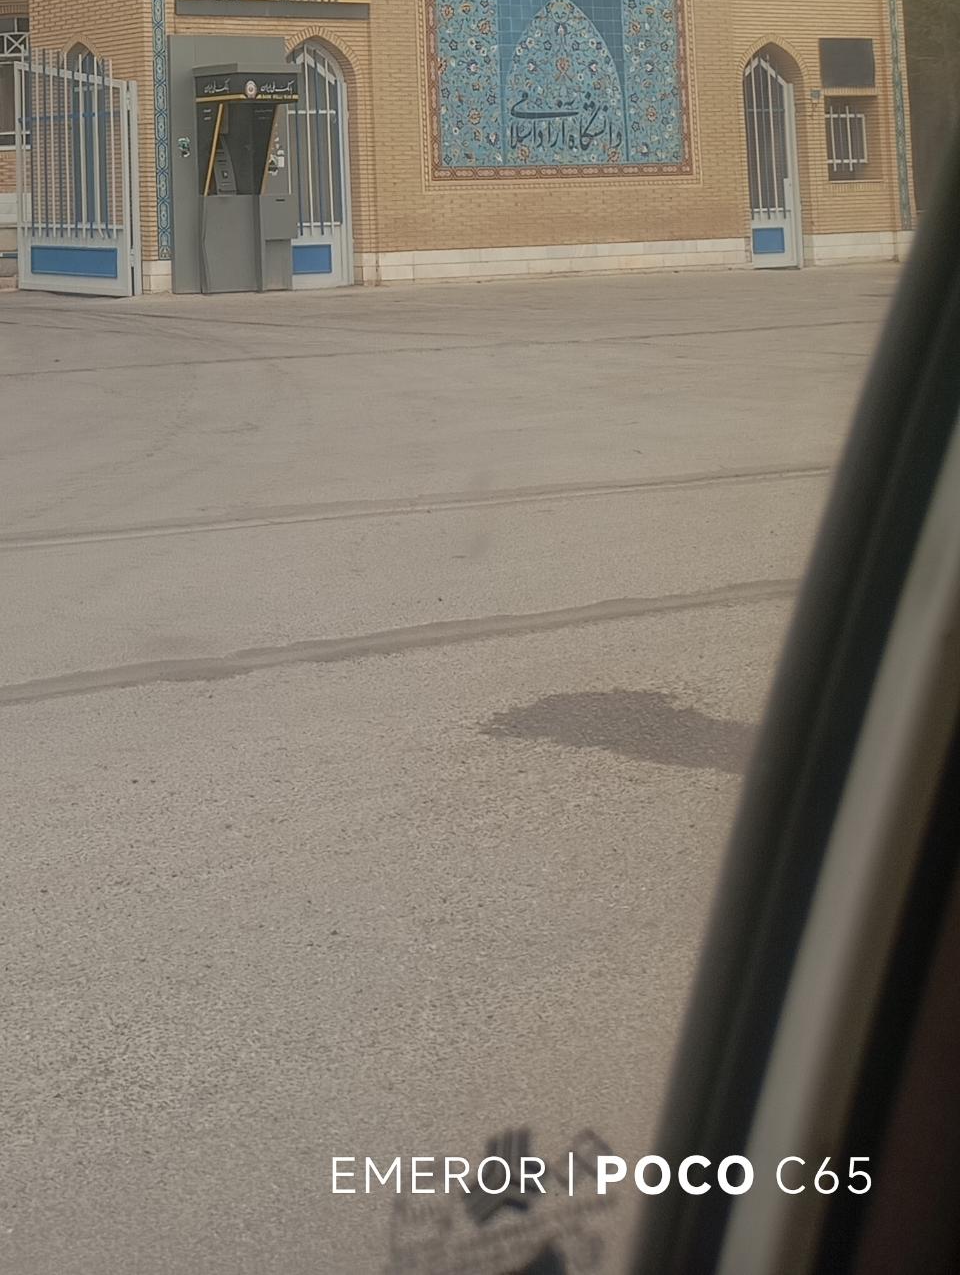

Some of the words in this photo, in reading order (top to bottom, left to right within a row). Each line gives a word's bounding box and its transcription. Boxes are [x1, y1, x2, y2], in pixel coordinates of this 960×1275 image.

[510, 91, 579, 150] اسلامی
[537, 97, 576, 149] آزاد
[568, 90, 623, 150] دانشگاه
